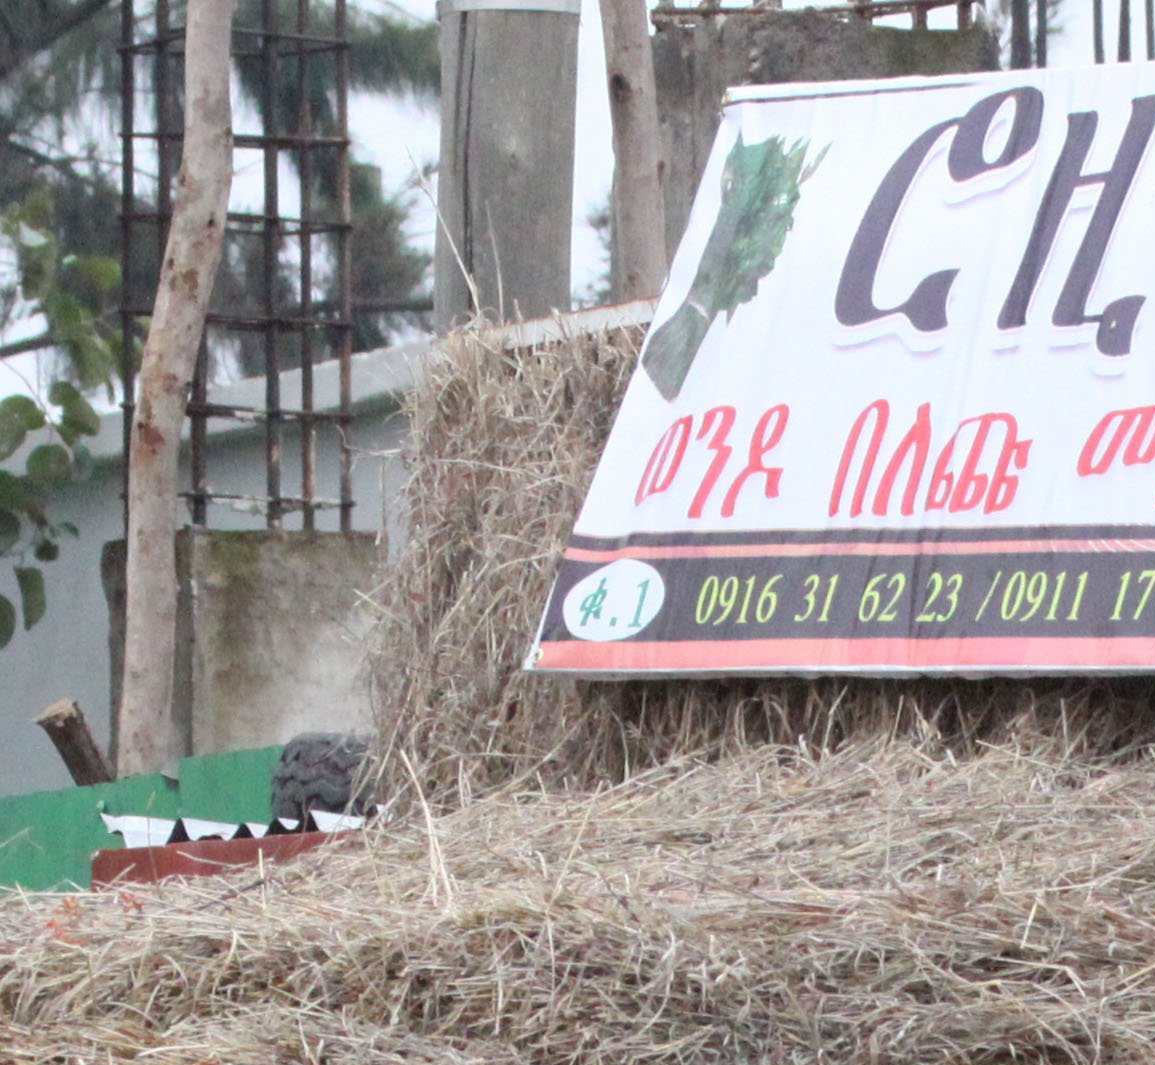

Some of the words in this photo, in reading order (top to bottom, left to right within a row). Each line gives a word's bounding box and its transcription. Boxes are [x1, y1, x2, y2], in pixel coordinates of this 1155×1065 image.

[635, 404, 790, 519] ወንዶ
[695, 574, 784, 625] 0916
[793, 573, 840, 622] 31
[857, 573, 906, 622] 62
[915, 572, 964, 622] 23
